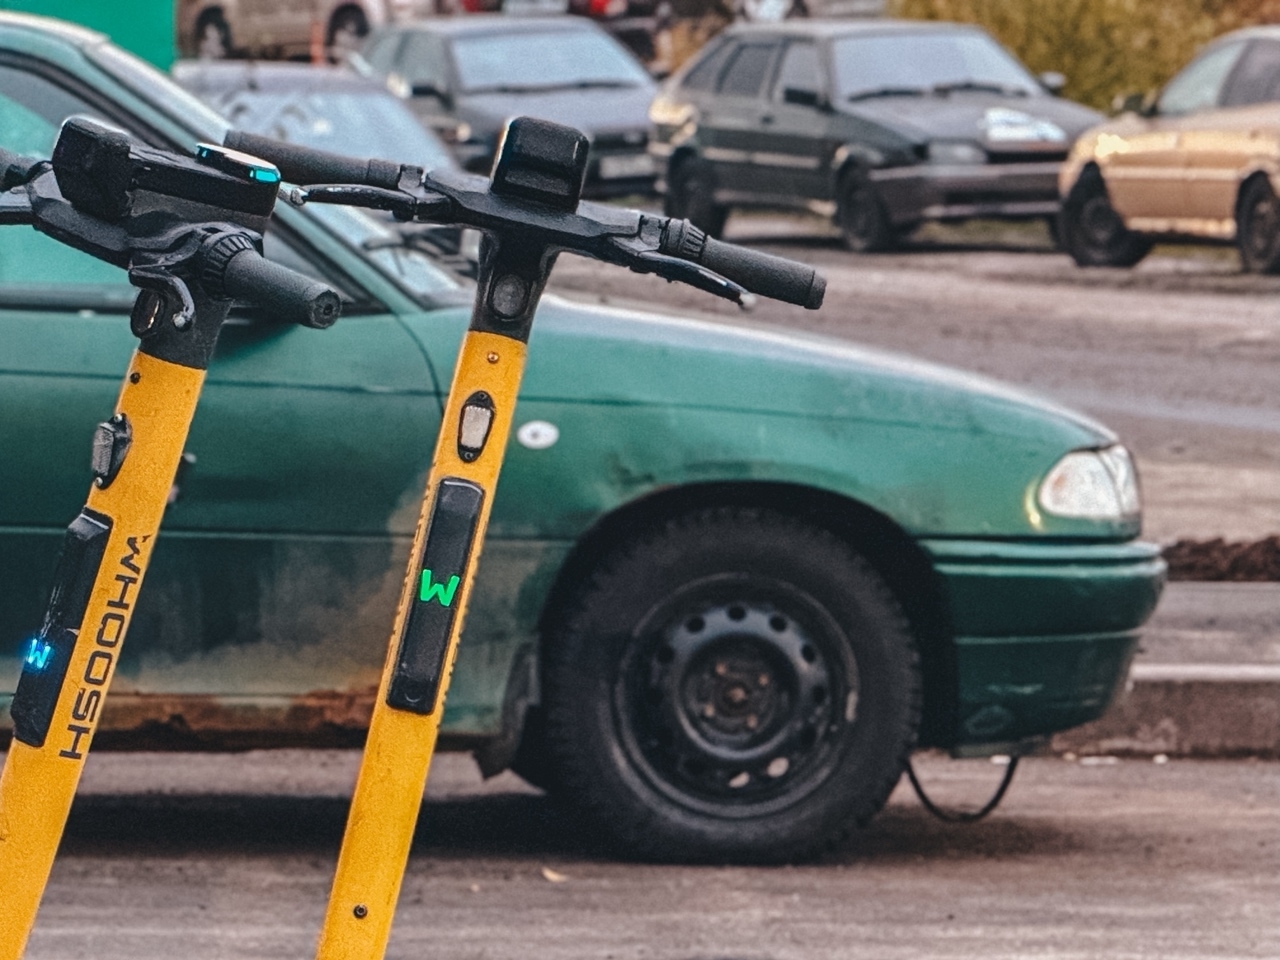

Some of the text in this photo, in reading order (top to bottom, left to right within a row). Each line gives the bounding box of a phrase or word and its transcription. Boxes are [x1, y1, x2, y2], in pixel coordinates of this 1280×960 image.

[420, 569, 460, 607] W
[27, 638, 51, 669] W
[59, 534, 152, 760] WHOOSH
